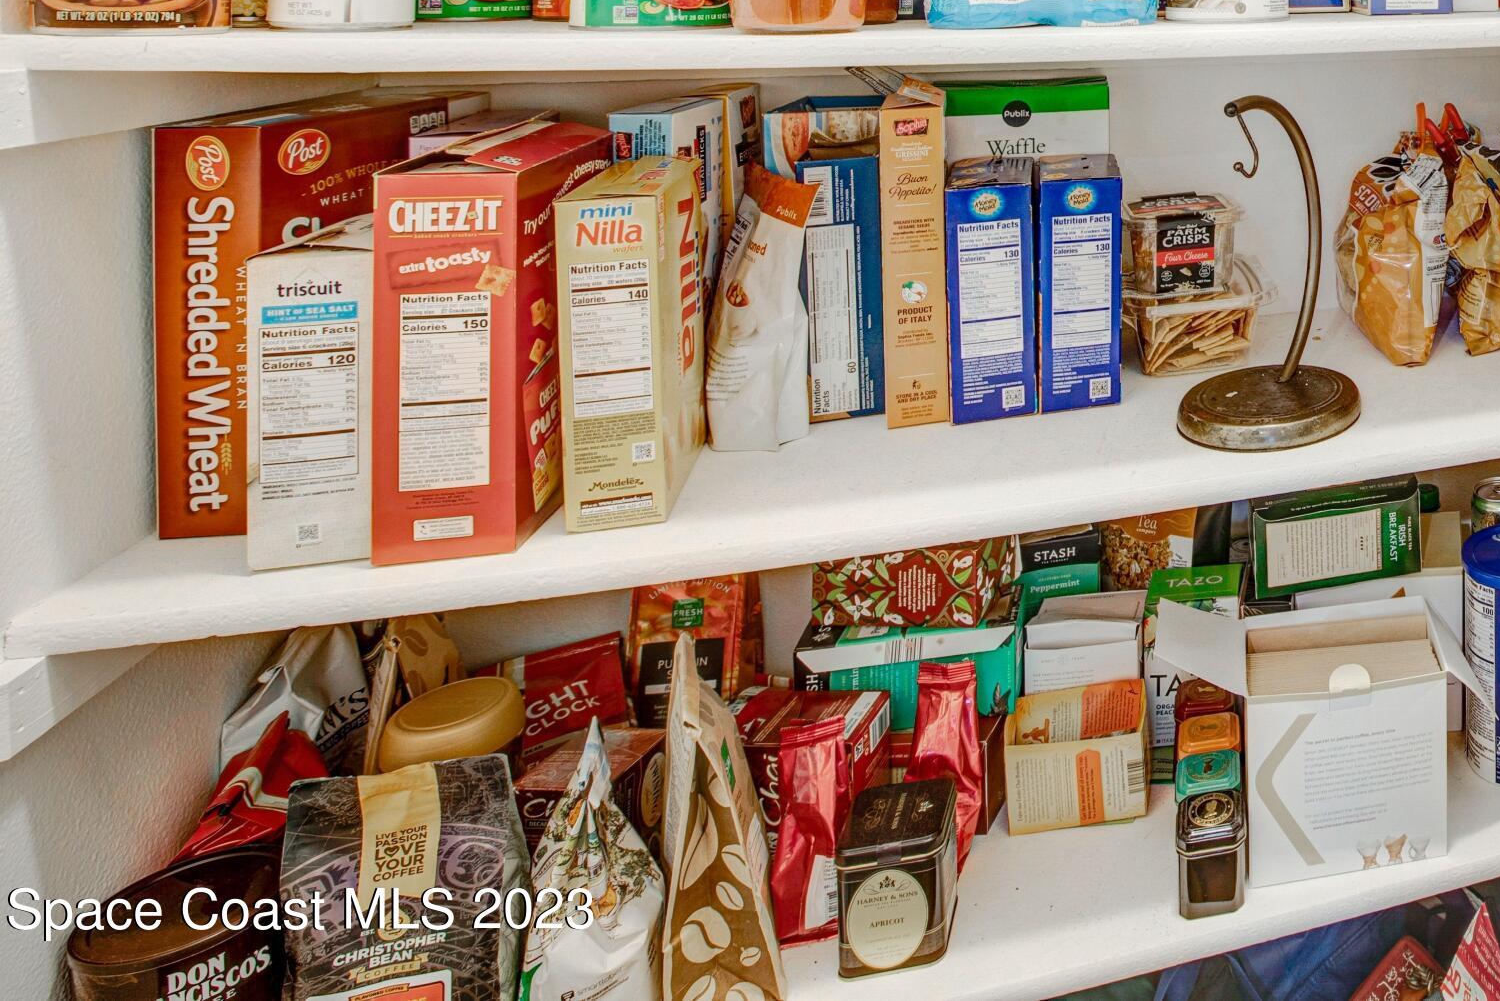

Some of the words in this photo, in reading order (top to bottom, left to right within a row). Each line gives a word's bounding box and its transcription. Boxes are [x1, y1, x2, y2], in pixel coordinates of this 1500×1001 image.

[1003, 108, 1030, 119] Publix
[288, 137, 324, 163] Post
[985, 138, 1046, 156] Waffle
[195, 144, 222, 182] Post
[309, 172, 344, 193] 100%
[346, 159, 388, 180] WHOLE
[898, 172, 928, 186] Buon
[319, 188, 365, 207] WHEAT
[888, 183, 936, 200] Appetito!
[579, 202, 633, 220] mini
[575, 219, 644, 247] Nilla
[959, 223, 993, 233] Nutrition
[996, 221, 1020, 230] Facts
[1166, 226, 1207, 237] PARM
[1162, 233, 1211, 246] CRISPS
[399, 261, 426, 274] extra
[425, 248, 491, 272] toasty
[960, 255, 986, 263] Calories
[1004, 250, 1019, 259] 130
[570, 264, 614, 273] Nutrition
[618, 260, 647, 271] Facts
[187, 197, 236, 378] Shredded
[276, 279, 342, 297] triscuit
[402, 294, 456, 303] Nutrition
[459, 293, 489, 302] Facts
[571, 295, 606, 305] Calories
[627, 289, 648, 300] 140
[897, 305, 933, 316] PRODUCT
[898, 316, 909, 324] OF
[910, 314, 932, 324] ITALY
[262, 327, 317, 338] Nutrition
[322, 325, 356, 335] Facts
[402, 322, 448, 333] Calories
[463, 318, 489, 329] 150
[262, 357, 313, 370] Calories
[327, 354, 356, 366] 120
[187, 383, 230, 512] Wheat
[1388, 511, 1398, 562] BREAKFAST
[1033, 545, 1077, 563] STASH
[1029, 578, 1081, 594] Peppermint
[1165, 573, 1223, 589] TAZO
[674, 608, 704, 619] FRESH
[758, 754, 781, 830] Chai
[375, 830, 398, 842] LIVE
[401, 825, 427, 838] YOUR
[375, 832, 427, 848] PASSION
[376, 852, 424, 873] YOUR
[373, 865, 424, 883] COFFEE
[857, 896, 886, 906] HARNEY
[897, 890, 918, 900] SONS
[870, 916, 905, 929] APRICOT
[332, 931, 447, 968] CHRISTOPHER
[368, 950, 413, 969] BEAN
[167, 952, 227, 996] DON
[363, 962, 415, 980] COFFEE
